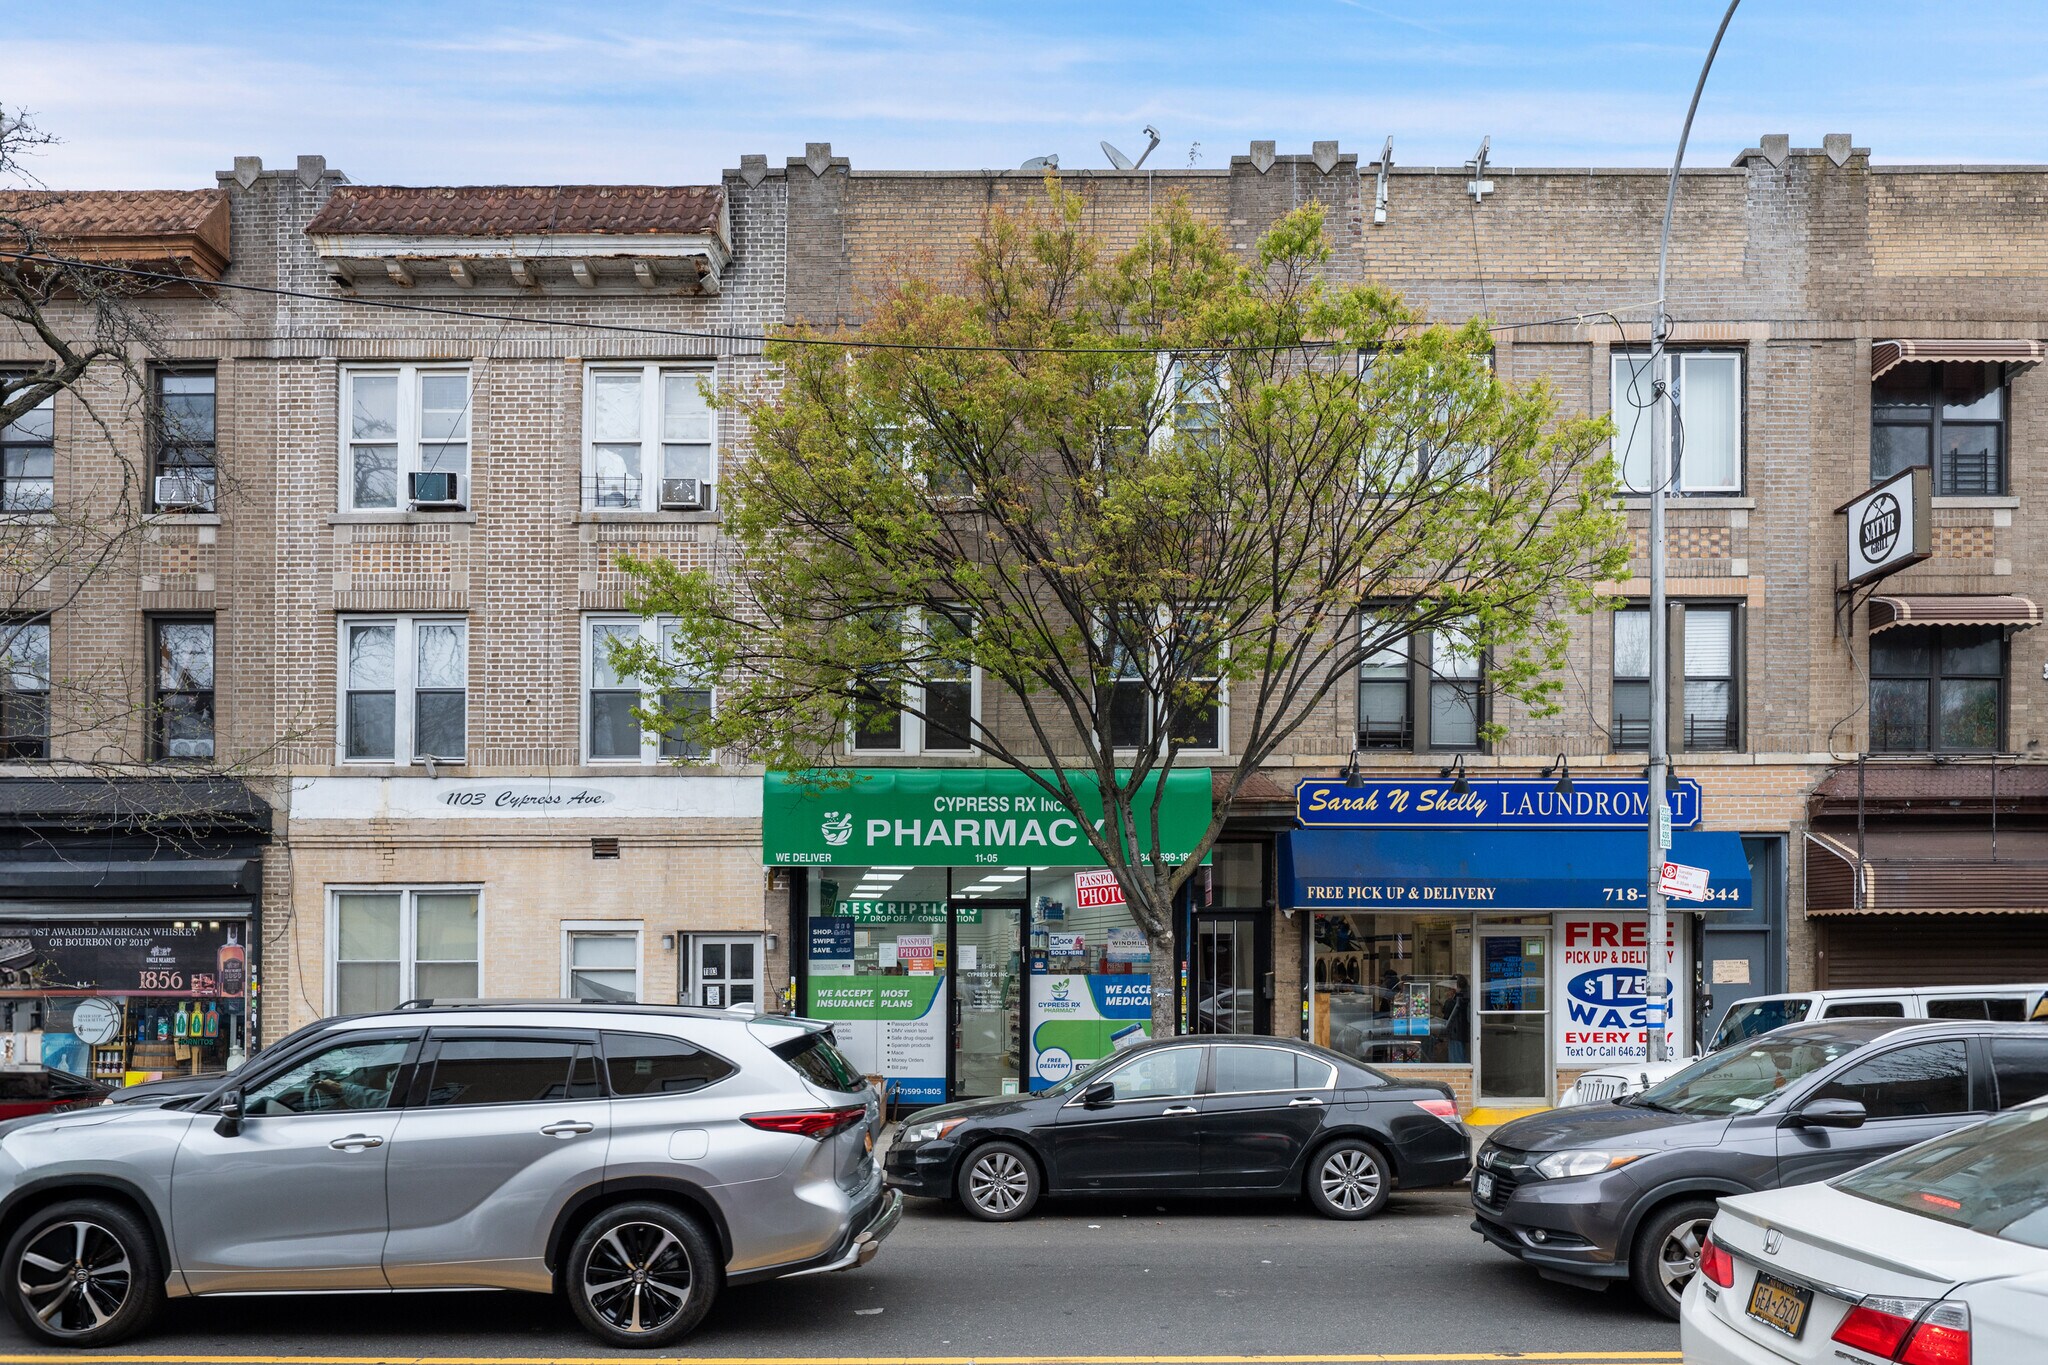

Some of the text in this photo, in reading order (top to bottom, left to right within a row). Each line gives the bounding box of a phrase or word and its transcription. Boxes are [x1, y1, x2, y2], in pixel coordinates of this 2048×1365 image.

[1864, 513, 1895, 543] SATYR
[1870, 537, 1888, 555] GRILL
[446, 790, 605, 808] 1103 Cypress Ave.
[933, 796, 1010, 812] CYPRESS
[1014, 796, 1036, 812] RX
[1308, 789, 1379, 811] Sarah
[1386, 789, 1408, 813] N
[1416, 789, 1488, 818] Shelly
[1500, 791, 1688, 816] LAUNDROMT
[775, 853, 832, 862] WE DELIVER
[975, 853, 998, 863] 11-05
[1307, 886, 1496, 900] FREE PICK UP & DELIVERY
[51, 927, 98, 936] AWARDED
[99, 927, 151, 937] AMERICAN
[152, 927, 198, 937] WHISKEY
[49, 938, 63, 947] OR
[64, 938, 112, 947] BOURBON
[114, 938, 128, 947] OF
[900, 937, 931, 946] PASSPORT
[1050, 936, 1073, 946] Mace
[900, 947, 931, 957] PHOTO
[1565, 951, 1591, 963] PICK
[1593, 951, 1608, 963] UP
[1610, 951, 1619, 963] &
[139, 970, 183, 989] 1856
[817, 989, 910, 998] WE ACCEPT MOST
[1105, 985, 1123, 994] WE
[816, 999, 913, 1008] INSURANCE PLANS
[1565, 1032, 1630, 1043] EVERY
[1565, 1046, 1584, 1057] Text
[1586, 1046, 1598, 1057] Or
[1599, 1046, 1616, 1057] Call
[1754, 1286, 1774, 1313] GEA
[1774, 1295, 1800, 1325] 2520
